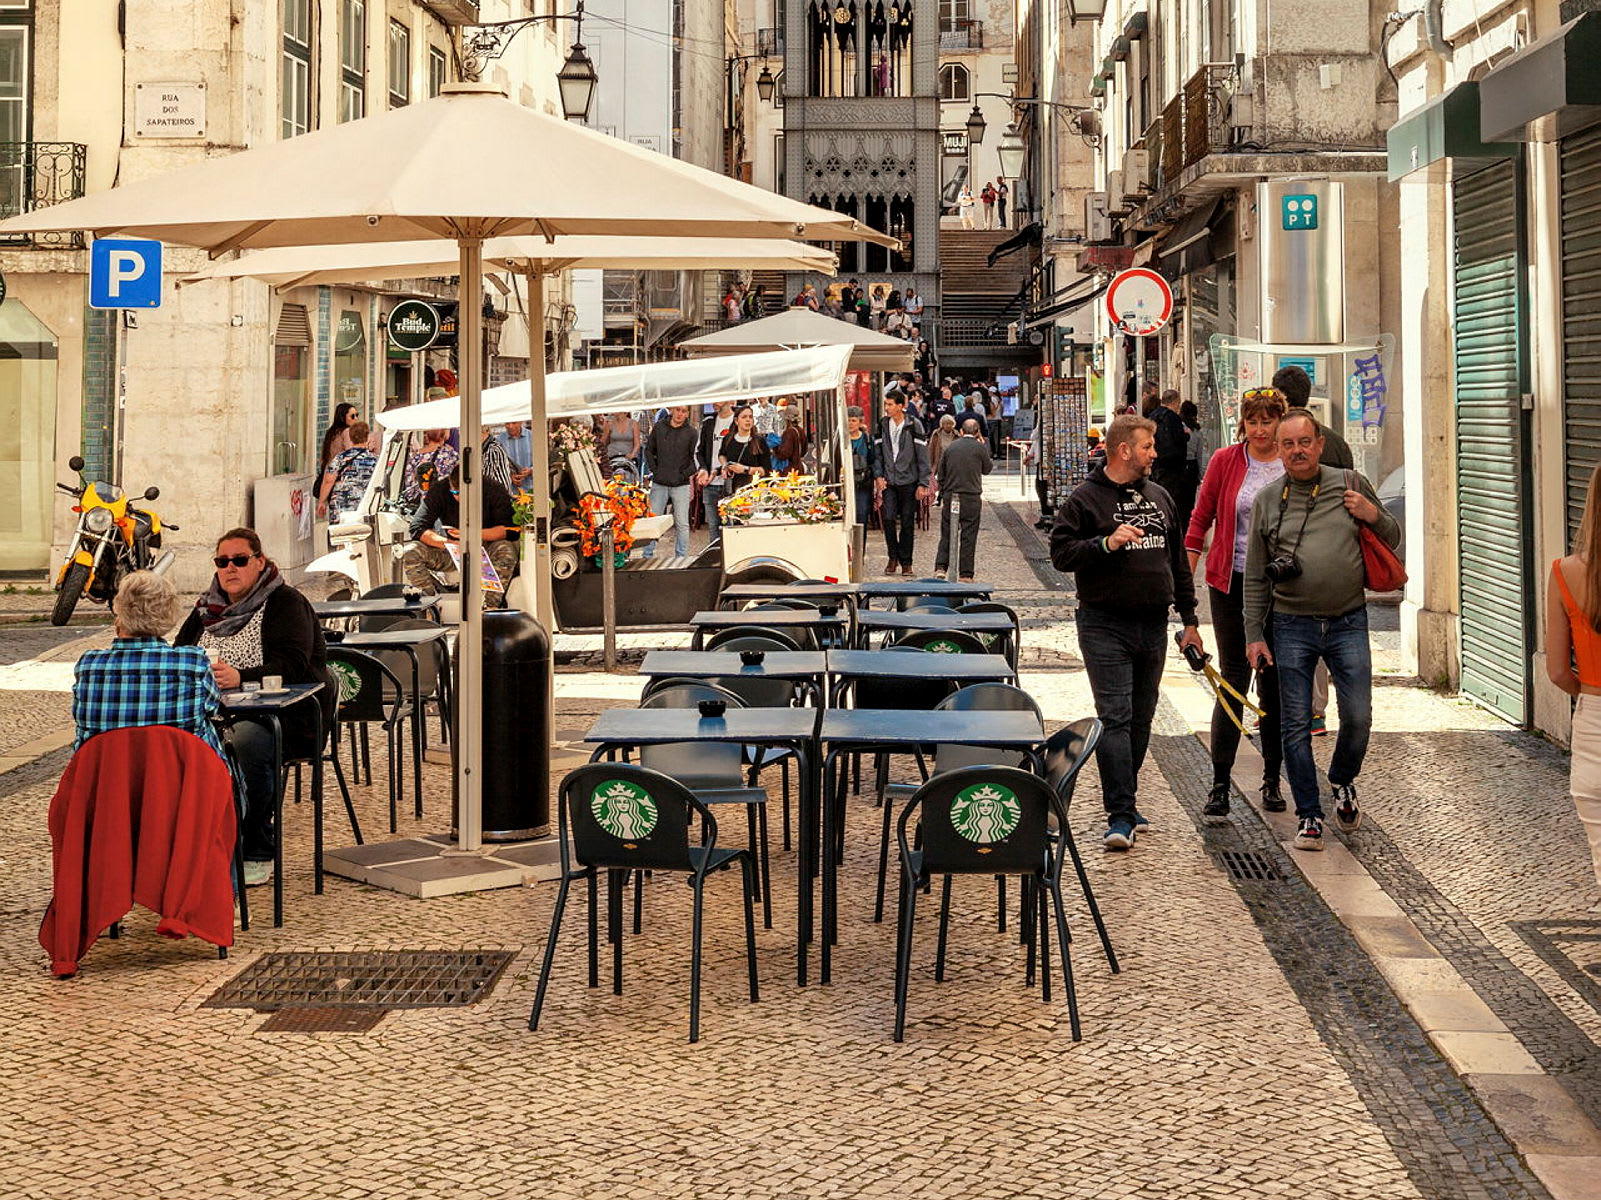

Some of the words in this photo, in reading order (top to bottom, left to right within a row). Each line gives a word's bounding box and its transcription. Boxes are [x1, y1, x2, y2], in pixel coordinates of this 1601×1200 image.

[162, 94, 179, 102] RUA
[163, 106, 179, 114] DOS
[146, 118, 195, 126] SAPATEIROS
[943, 136, 968, 148] MUJI
[108, 250, 146, 298] P
[402, 318, 422, 326] Bud
